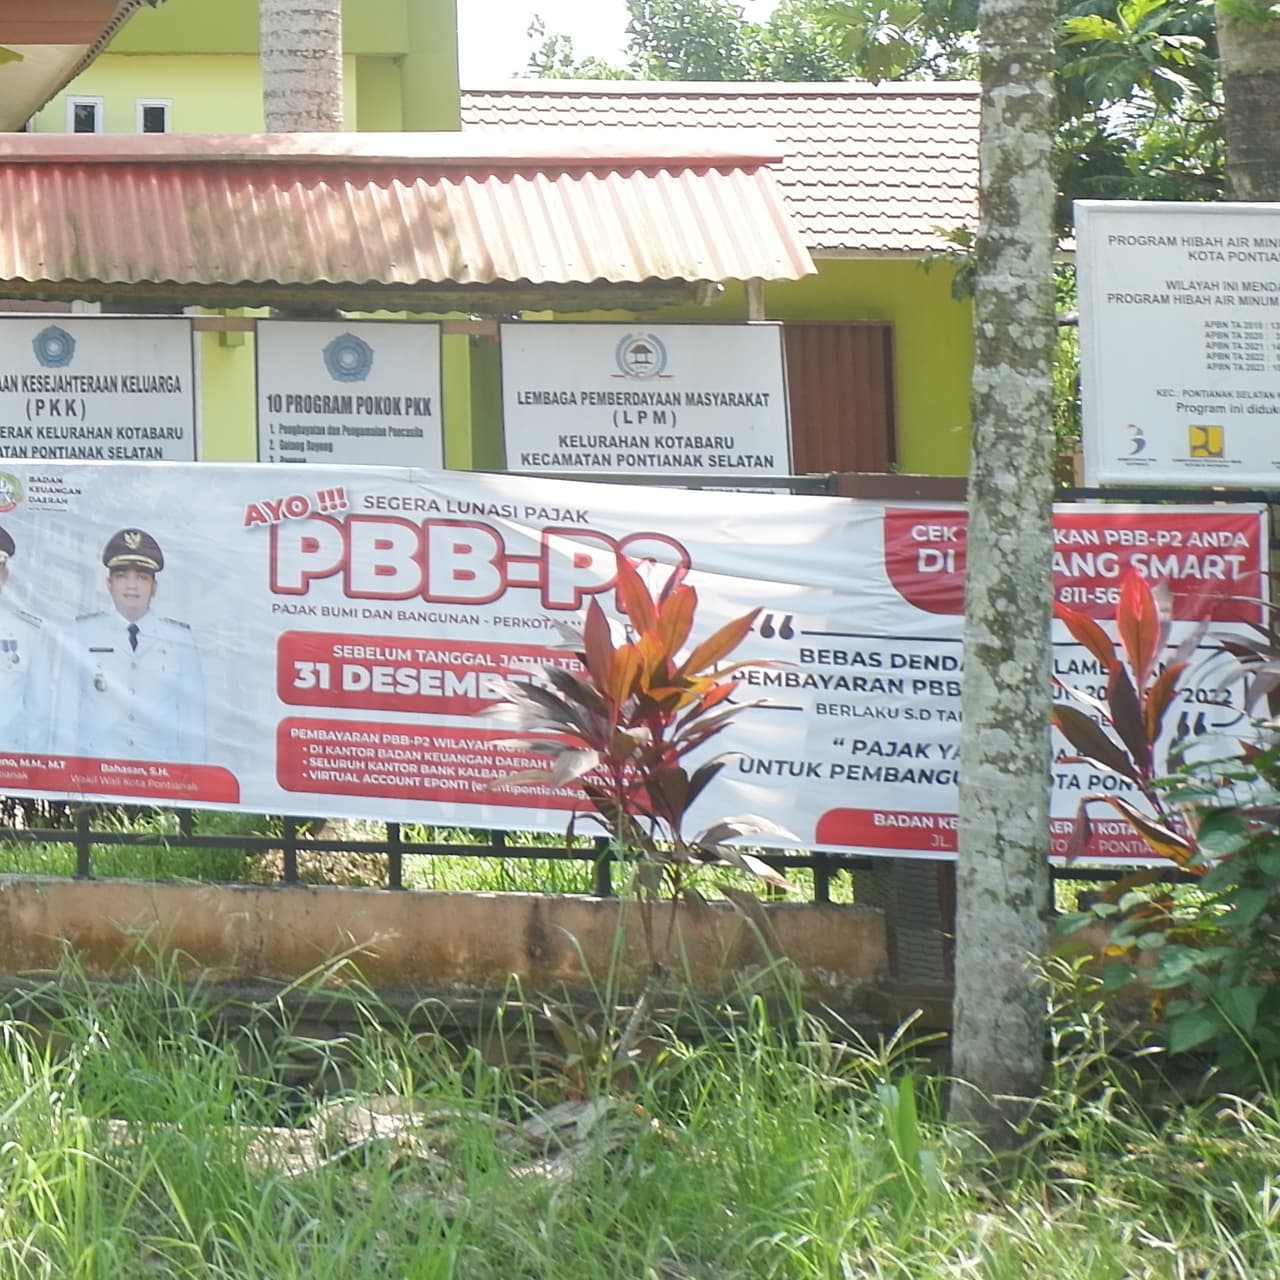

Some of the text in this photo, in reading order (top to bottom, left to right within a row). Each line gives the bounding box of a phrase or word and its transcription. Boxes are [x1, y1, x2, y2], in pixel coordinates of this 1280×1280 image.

[1108, 235, 1177, 246] PROGRAM
[1181, 236, 1223, 247] HIBAH
[1227, 237, 1250, 248] AIR
[1188, 251, 1225, 261] KOTA
[1165, 280, 1219, 291] WILAYAH
[1223, 281, 1239, 291] INI
[1107, 293, 1279, 307] PROGRAM HIBAH AIR MINUM
[22, 375, 118, 393] KESEJAHTERAAN
[121, 375, 182, 393] KELUARGA
[517, 391, 770, 407] LEMBAGA PEMBERDAYAAN MASYARAKAT
[1182, 389, 1233, 398] PONTIANAK
[1236, 390, 1275, 399] SELATAN
[266, 394, 431, 416] 10 PROGRAM POKOK PKK
[1176, 401, 1226, 415] Program
[1230, 402, 1243, 414] ini
[37, 426, 112, 439] KELURAHAN
[116, 427, 183, 440] KOTABARU
[559, 435, 734, 449] KELURAHAN KOTABARU
[32, 446, 103, 458] PONTIANAK
[108, 447, 163, 459] SELATAN
[521, 453, 774, 468] KECAMATAN PONTIANAK SELATAN
[28, 476, 64, 484] BADAN
[28, 486, 82, 495] KEUANGAN
[28, 496, 69, 505] DAERAH
[363, 494, 589, 524] SEGERA LUNASI PAJAK
[243, 496, 310, 526] AYO
[911, 524, 958, 542] CEK
[1103, 529, 1182, 548] PBB-P2
[1186, 531, 1249, 548] ANDA
[918, 548, 955, 573] DI
[1130, 552, 1246, 581] SMART
[272, 604, 318, 618] PAJAK
[321, 606, 358, 619] BUMI
[362, 608, 394, 621] DAN
[398, 609, 479, 625] BANGUNAN
[333, 645, 411, 661] SEBELUM
[415, 648, 495, 666] TANGGAL
[800, 647, 964, 672] BEBAS DEND
[293, 661, 330, 690] 31
[1183, 687, 1233, 704] 2022
[816, 703, 899, 720] BERLAKU
[904, 707, 932, 720] S.D
[290, 728, 496, 751] PEMBAYARAN PBB-P2 WILAYAH
[309, 744, 547, 769] DI KANTOR BADAN KEUANGAN DAERAH
[851, 738, 931, 759] PAJAK
[309, 757, 507, 779] SELURUH KANTOR BANK KALBAR
[738, 757, 822, 778] UNTUK
[71, 773, 198, 791] Wakil Wali Kota Pontianak
[310, 770, 469, 790] VIRTUAL ACCOUNT EPONTI
[873, 812, 934, 828] BADAN
